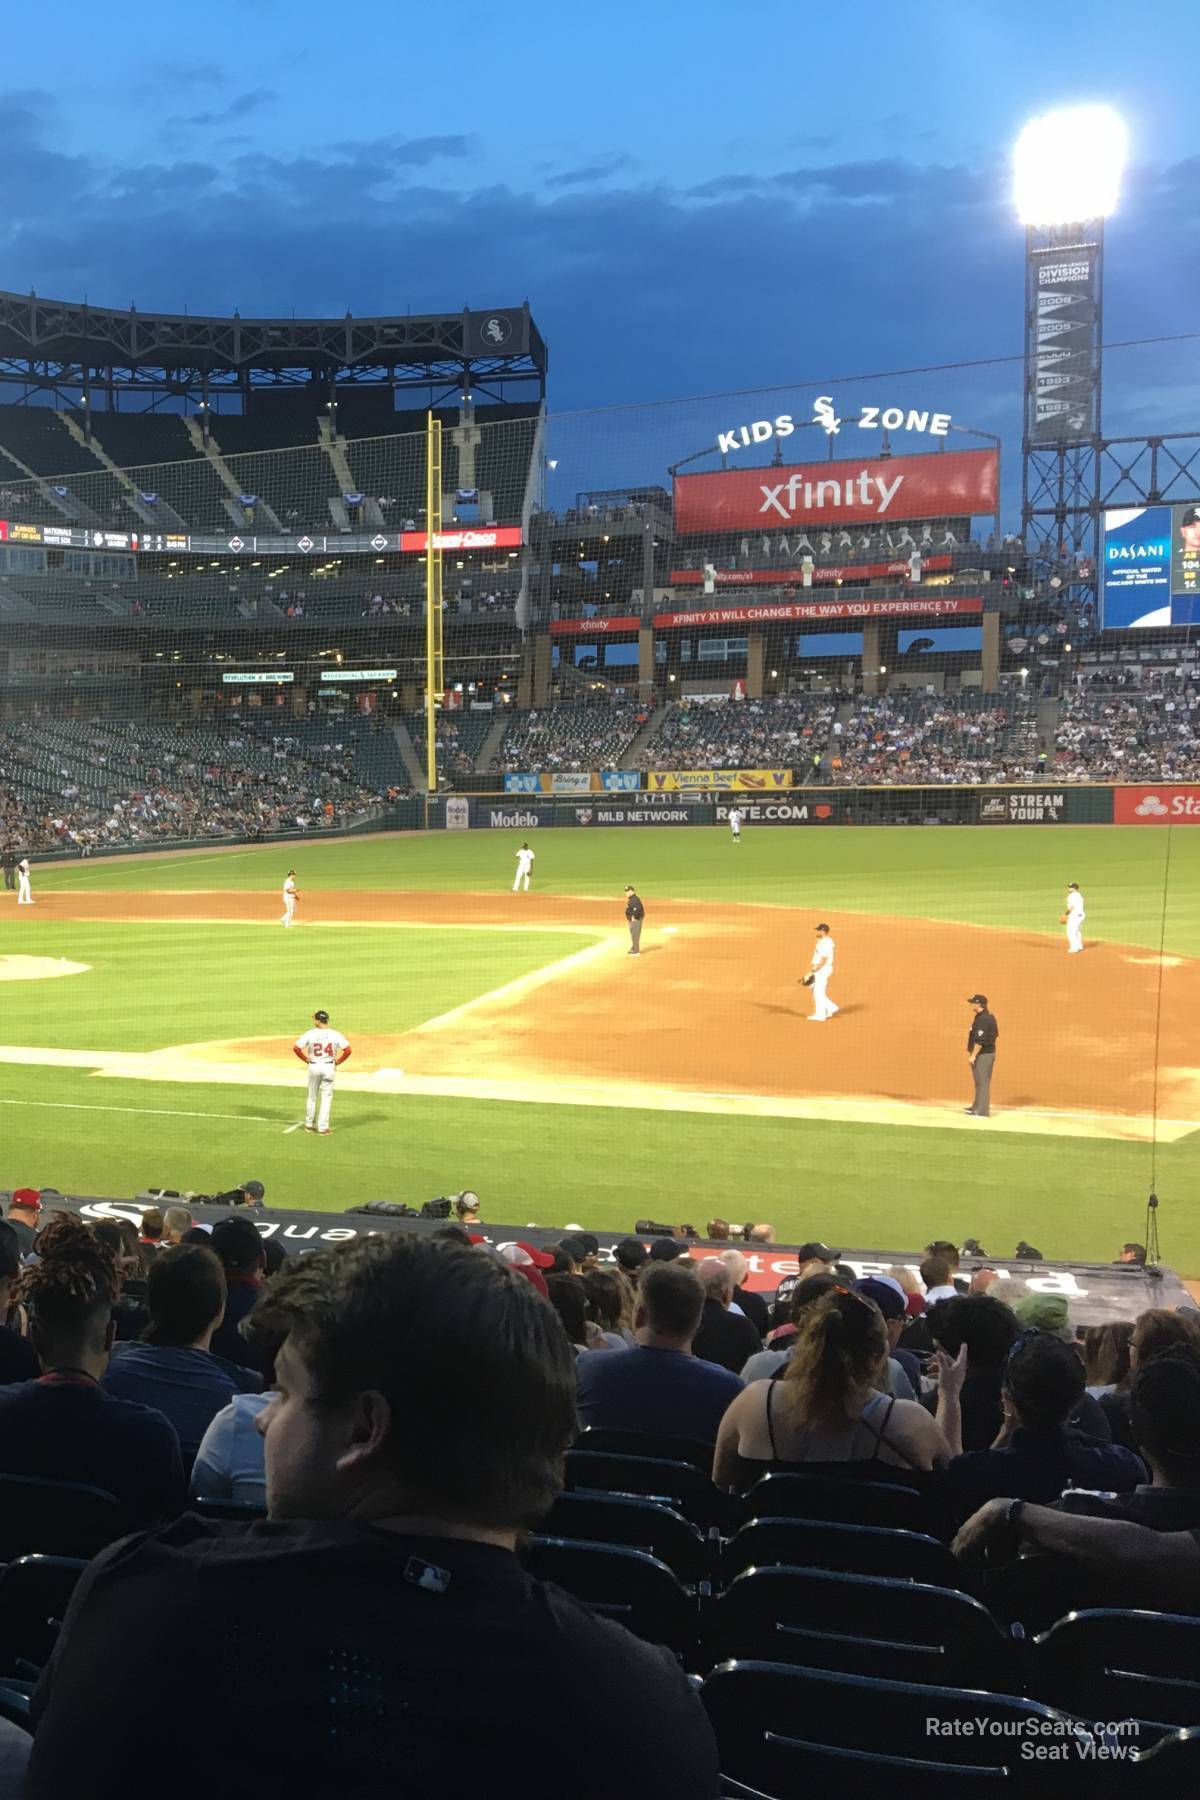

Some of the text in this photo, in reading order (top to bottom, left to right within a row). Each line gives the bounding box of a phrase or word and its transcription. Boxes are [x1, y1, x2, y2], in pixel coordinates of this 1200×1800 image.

[1039, 266, 1089, 279] DIVISION
[1040, 274, 1089, 285] CHAMPIONS
[1040, 296, 1072, 305] 2008
[1040, 323, 1071, 332] 2005
[718, 414, 794, 453] KIDS
[858, 406, 951, 436] ZONE
[760, 469, 904, 519] xfinity
[44, 527, 72, 537] NATIONALS
[44, 536, 59, 544] WHITE
[60, 537, 72, 545] SOX
[1109, 544, 1164, 560] DASANI
[1182, 561, 1200, 569] 104
[816, 569, 843, 579] xfinity
[1184, 581, 1197, 589] 14
[673, 600, 958, 625] XFINITY X1 WILL CHANGE THE WAY YOU EXPERIENCE TV
[580, 620, 608, 631] xfinity
[672, 772, 738, 783] Vienna Beef
[1010, 795, 1063, 806] STREAM
[490, 811, 539, 827] Modelo
[598, 810, 688, 822] MLB NETWORK
[1009, 808, 1044, 819] YOUR
[313, 1042, 334, 1057] 24
